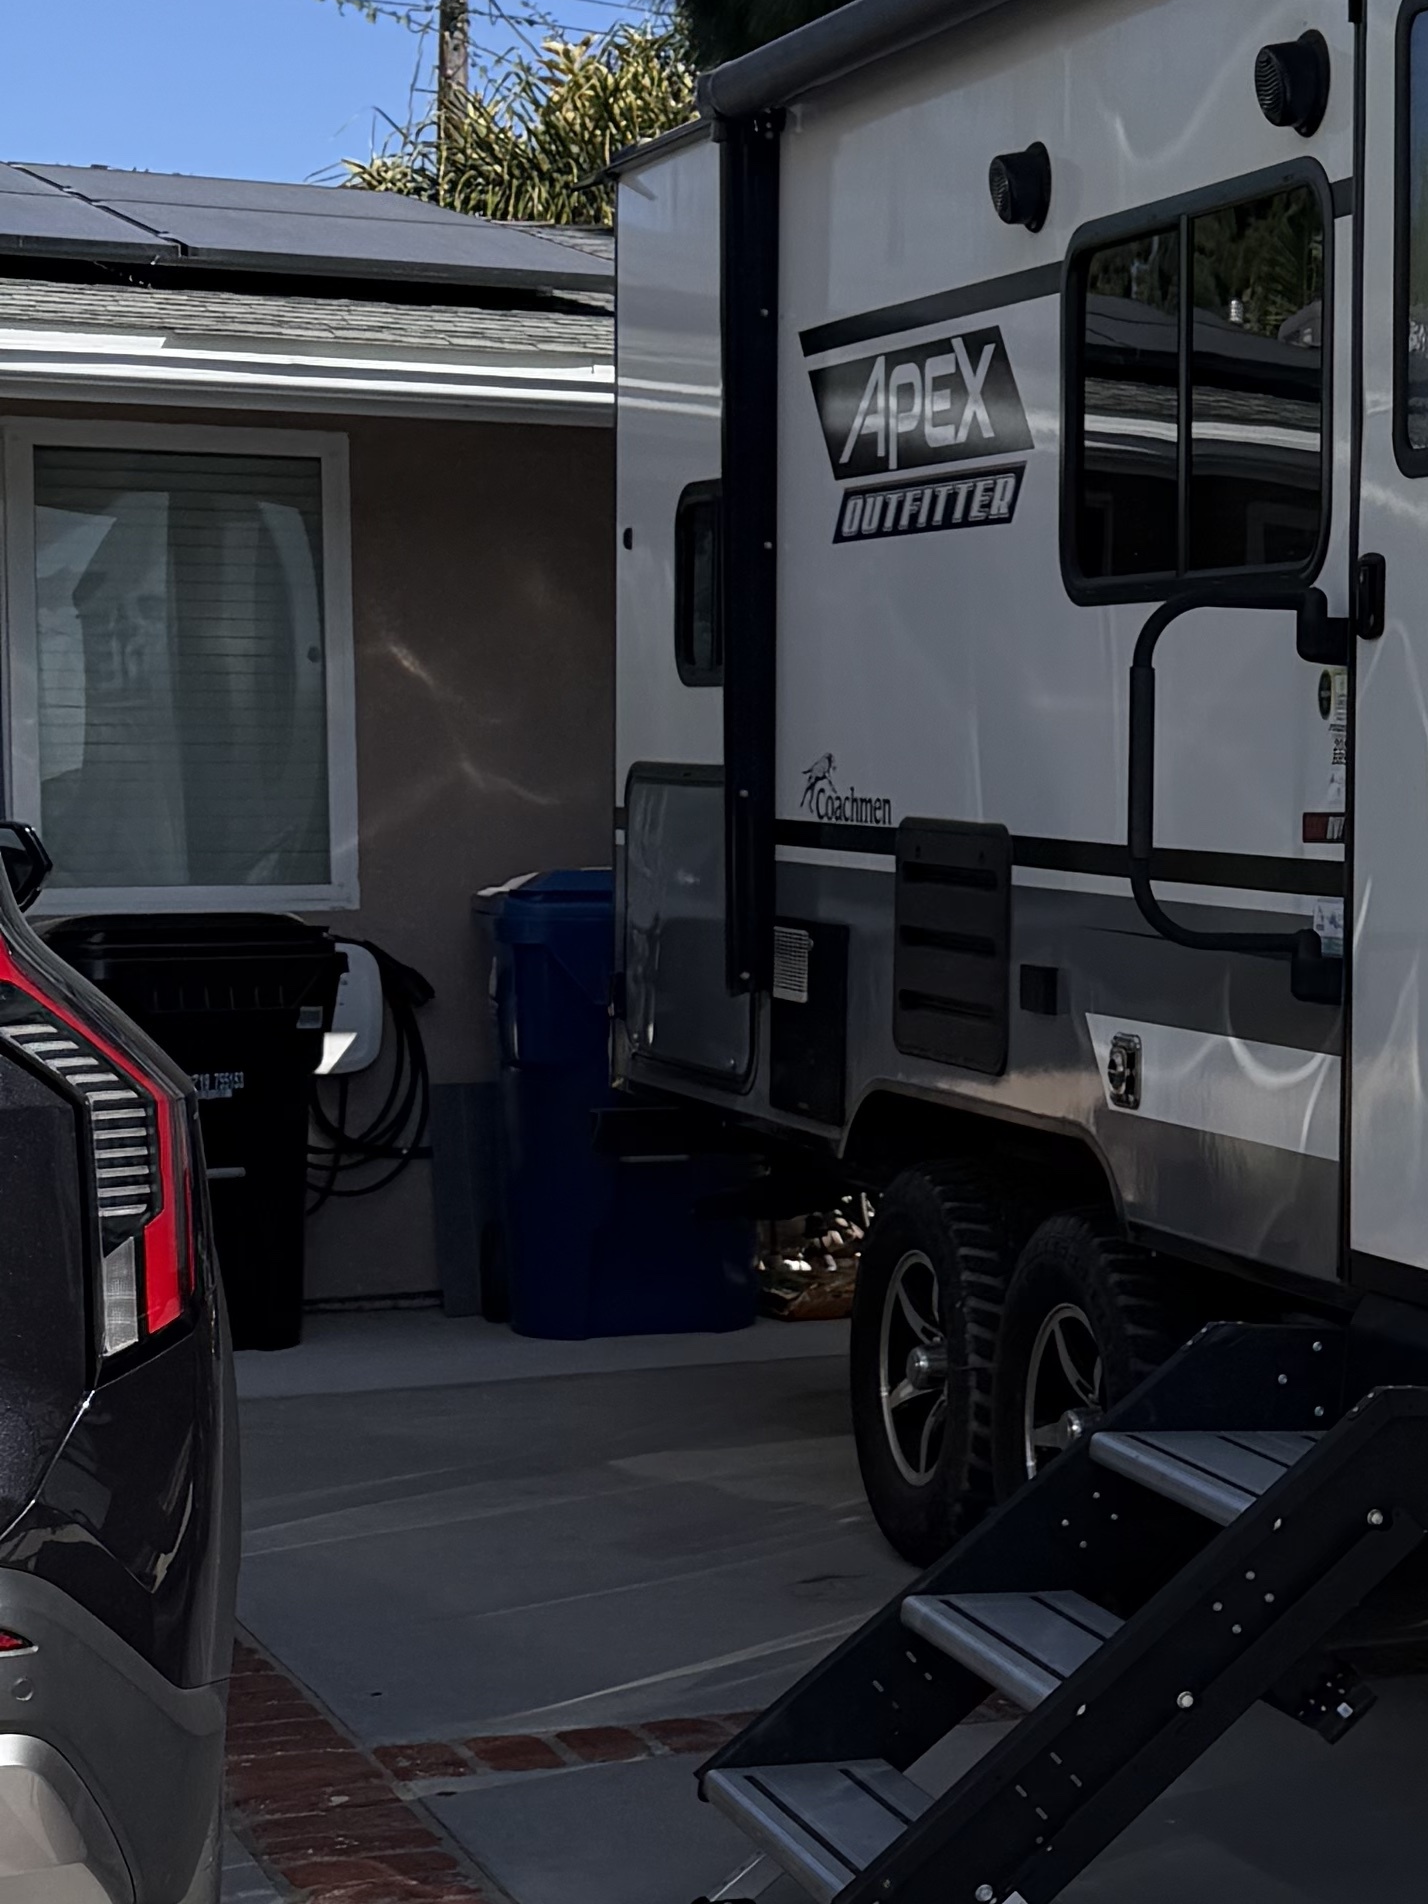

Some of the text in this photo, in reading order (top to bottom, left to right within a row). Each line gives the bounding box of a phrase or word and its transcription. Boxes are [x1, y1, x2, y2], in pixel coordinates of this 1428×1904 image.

[838, 336, 997, 470] APEX
[841, 473, 1017, 537] OUTFITTER
[815, 786, 892, 825] Coachmen
